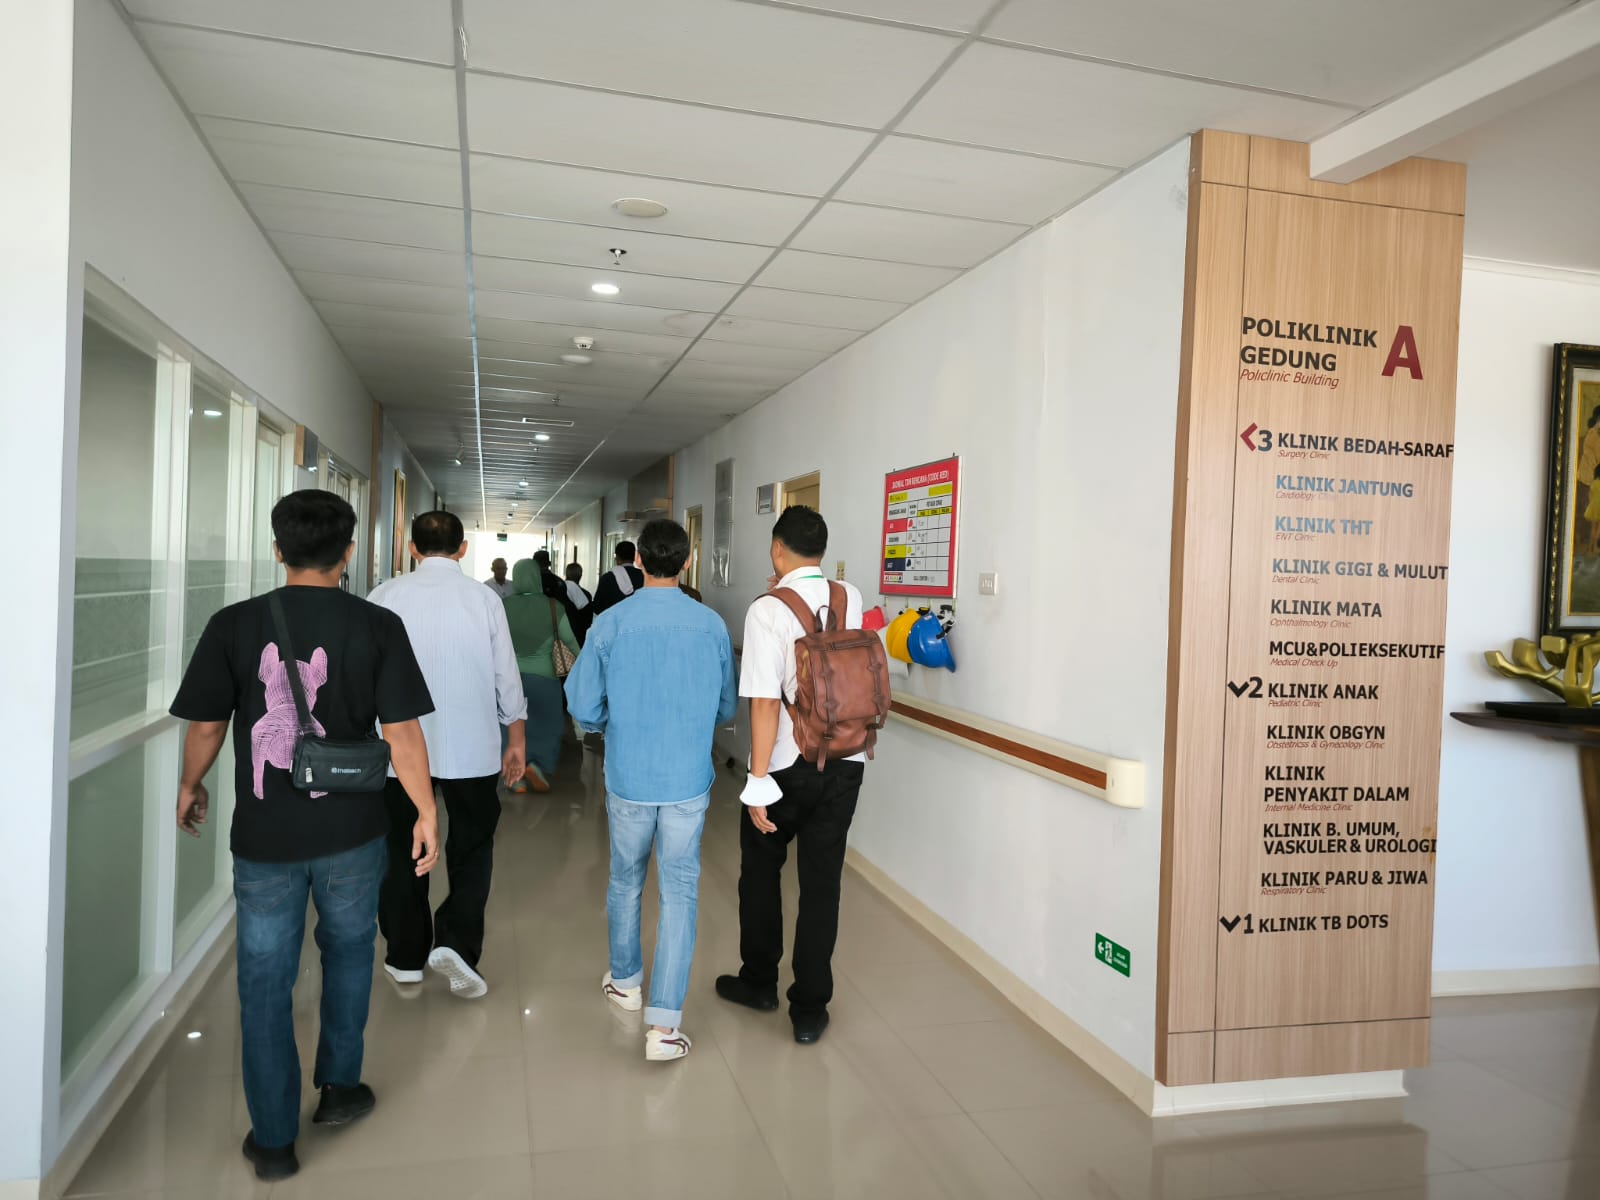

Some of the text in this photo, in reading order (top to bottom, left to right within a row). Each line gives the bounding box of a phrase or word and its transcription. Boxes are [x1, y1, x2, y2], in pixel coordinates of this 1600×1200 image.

[1242, 317, 1377, 347] POLIKLINIK
[1241, 346, 1337, 371] GEDUNG
[1382, 325, 1424, 380] A
[1240, 369, 1339, 389] Policlinic Building
[1258, 430, 1454, 458] 3 KLINIK BEDAH-SARAF
[1278, 450, 1331, 460] Surgery Clinic
[1276, 475, 1413, 497] KLINIK JANTUNG
[1275, 516, 1373, 535] KLINIK THT
[1272, 559, 1448, 580] KLINIK GIGI & MULUT
[1272, 575, 1320, 584] Dental Clinic
[1271, 600, 1382, 617] KLINIK MATA
[1270, 658, 1300, 666] Medical
[1327, 660, 1338, 668] Up
[1248, 677, 1378, 700] 2 KLINIK ANAK
[1302, 700, 1323, 708] Clinic
[1267, 725, 1385, 739] KLINIK OBGYN
[1265, 766, 1325, 780] KLINIK
[1264, 787, 1409, 802] PENYAKIT DALAM
[1265, 804, 1296, 812] Internal
[1263, 822, 1400, 838] KLINIK B. UMUM,
[1264, 839, 1437, 854] VASKULER & UROLOGI
[1261, 870, 1428, 887] KLINIK PARU & JIWA
[1243, 914, 1388, 934] 1 KLINIK TB DOTS
